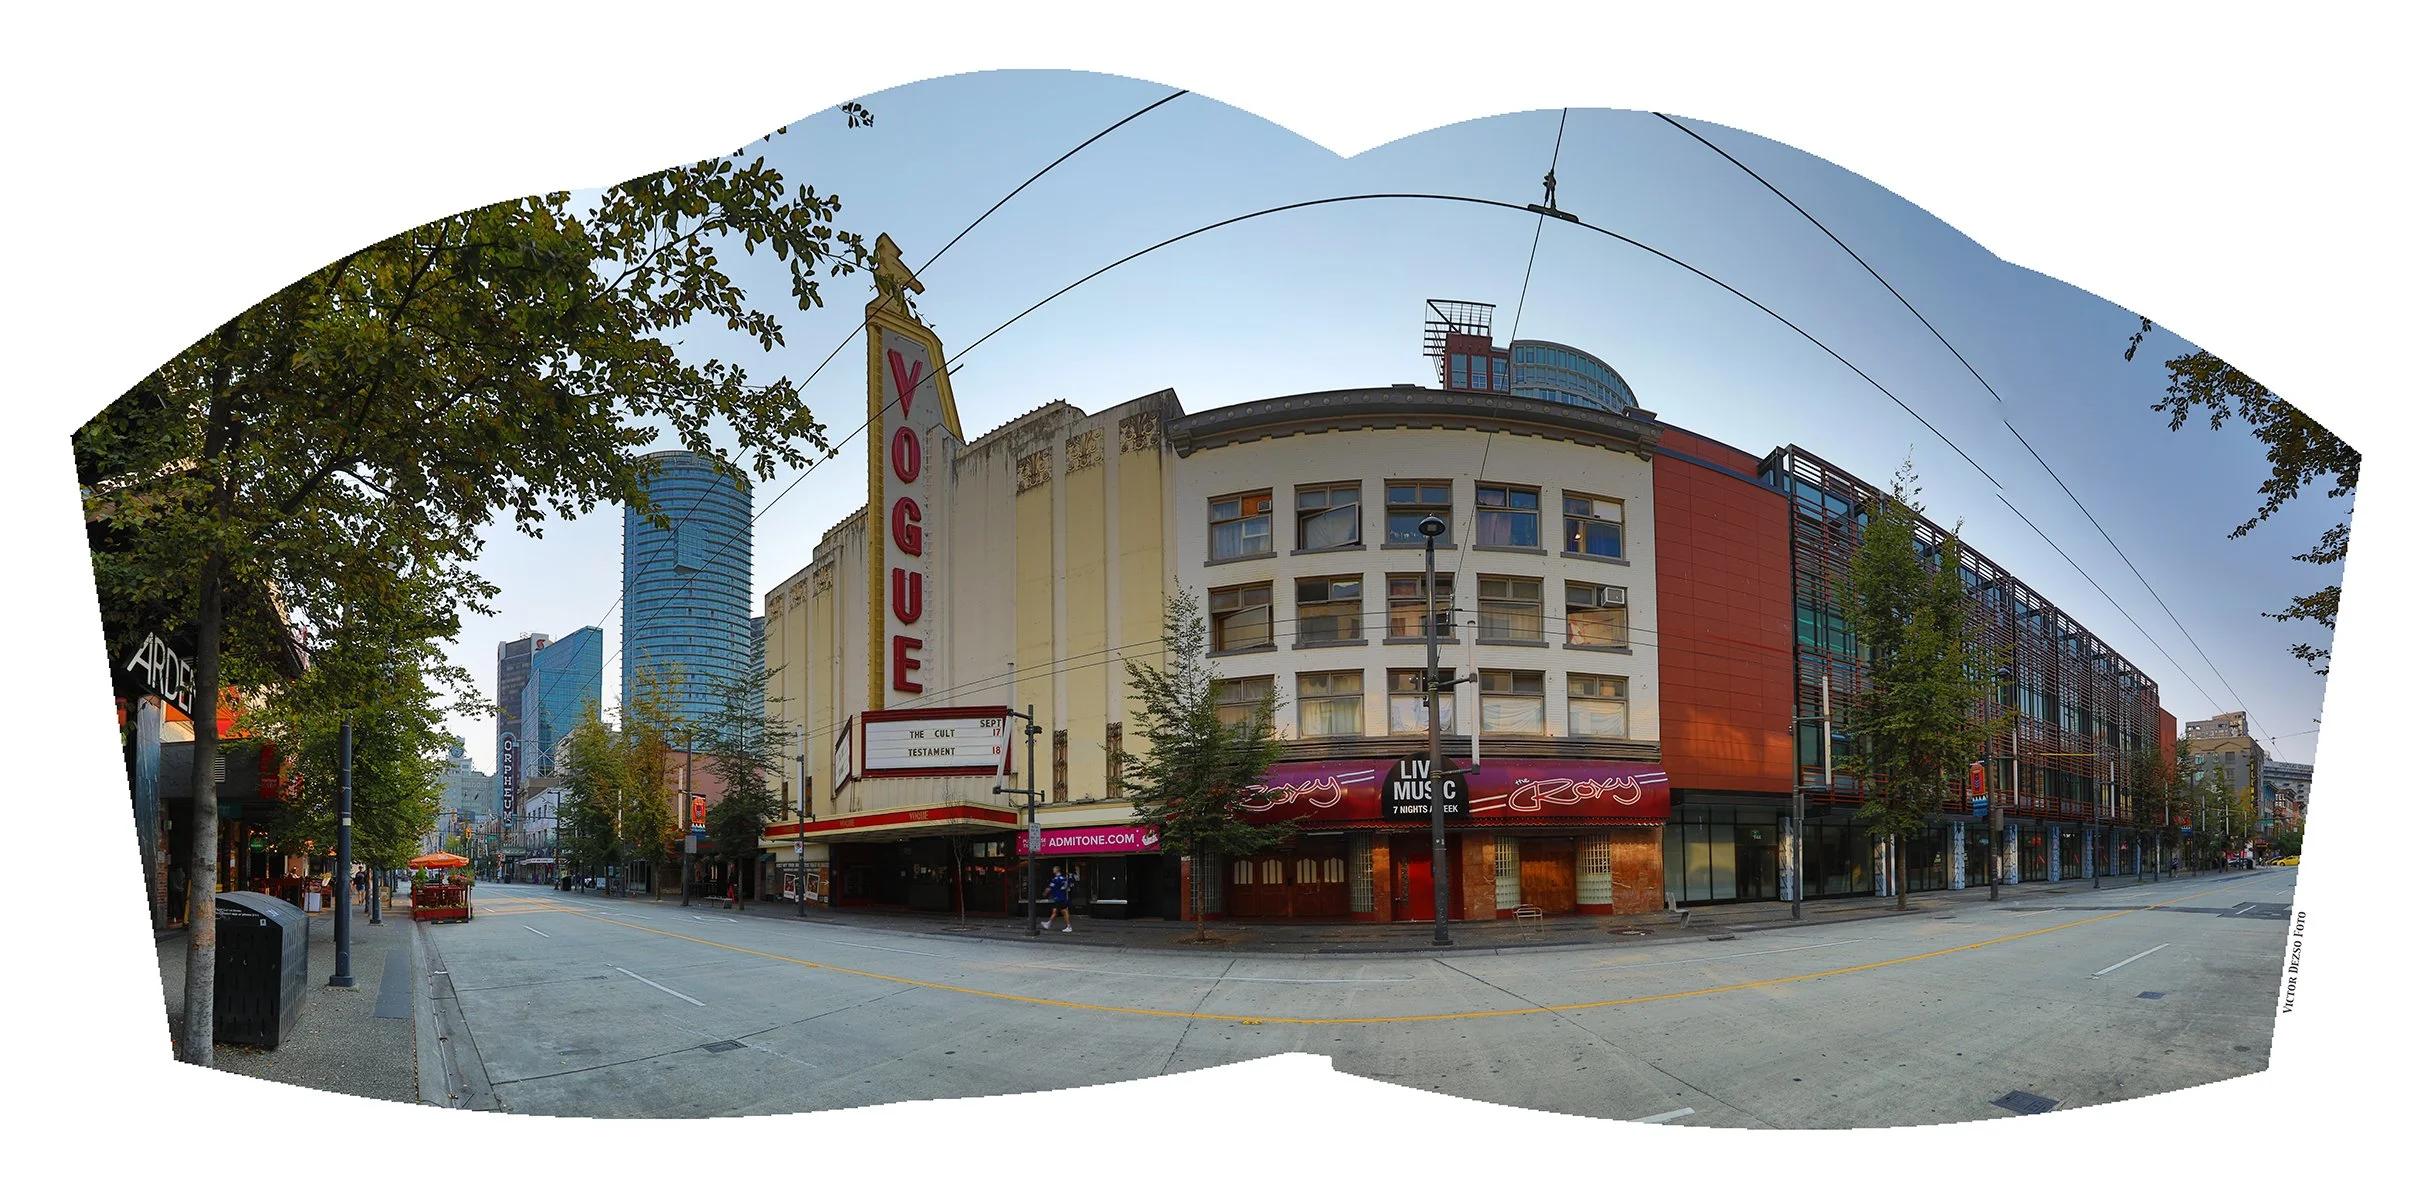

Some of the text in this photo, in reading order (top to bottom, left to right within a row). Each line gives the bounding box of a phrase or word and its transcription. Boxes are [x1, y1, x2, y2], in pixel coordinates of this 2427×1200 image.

[888, 348, 923, 694] VOGUE
[980, 719, 1002, 728] SEPT
[909, 729, 955, 739] THE CULT
[992, 728, 1001, 737] 17
[908, 747, 955, 757] TESTAMENT
[992, 746, 1001, 755] 18
[1400, 760, 1431, 779] LIV
[503, 740, 512, 820] ORPHEUM
[1393, 780, 1456, 800] MUSC
[1508, 775, 1642, 812] the Roxy
[1393, 806, 1399, 814] 7
[1400, 805, 1428, 813] NIGHTS
[909, 811, 929, 820] VOGUE
[1048, 833, 1135, 847] ADMITONE.COM
